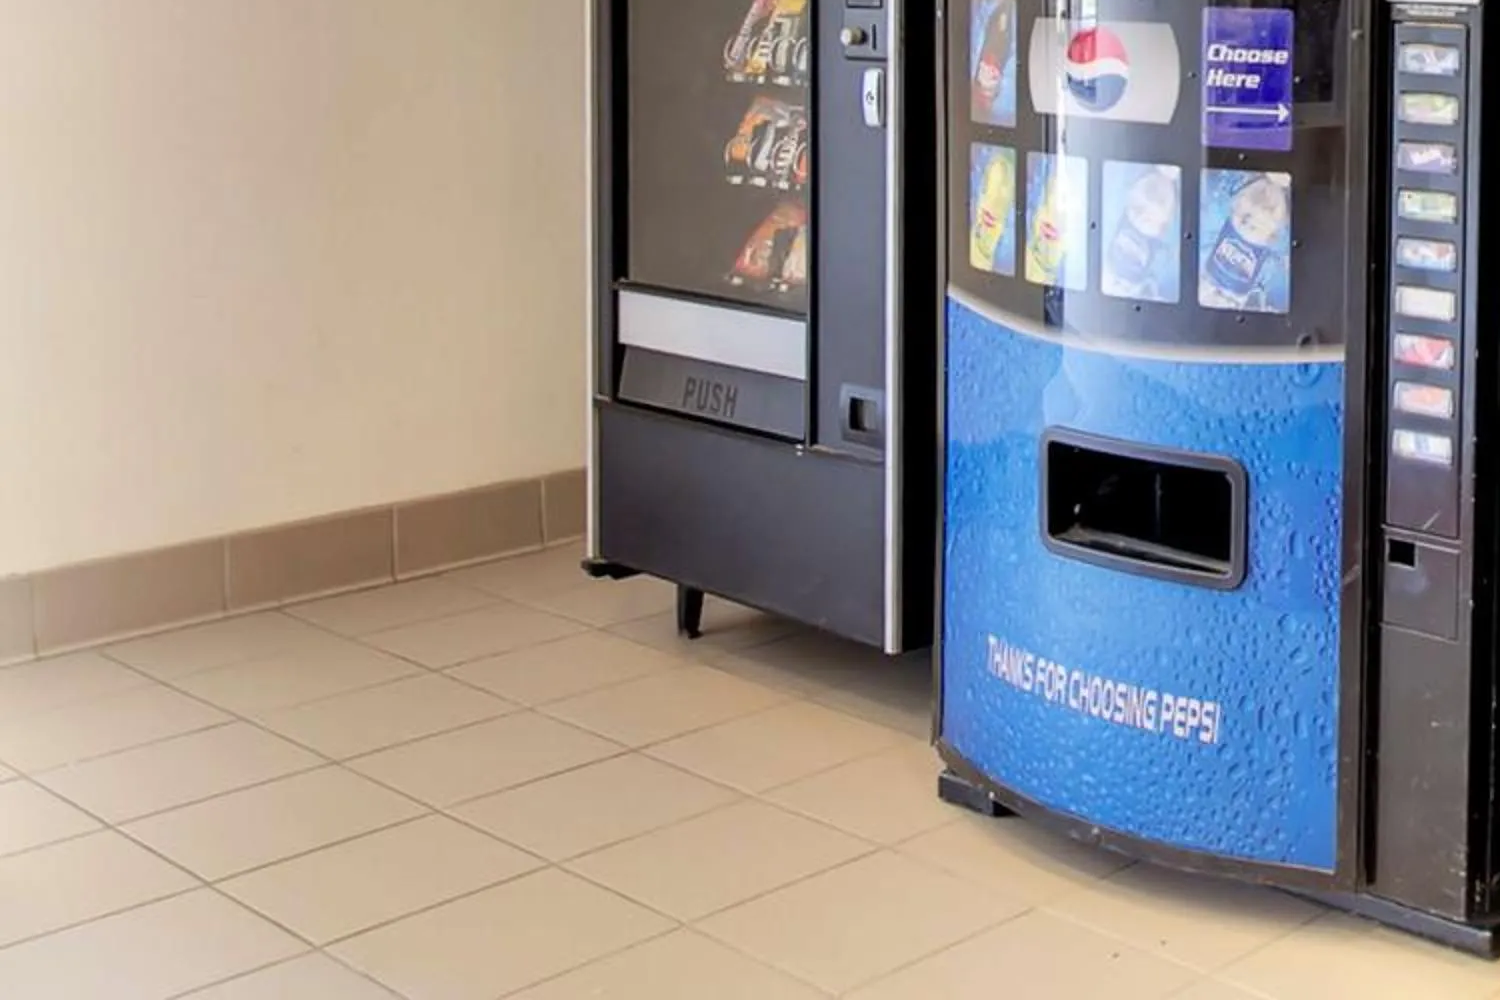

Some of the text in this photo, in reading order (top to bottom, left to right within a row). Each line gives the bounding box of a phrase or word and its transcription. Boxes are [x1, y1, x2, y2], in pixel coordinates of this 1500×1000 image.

[1207, 43, 1289, 65] Choose
[1206, 68, 1261, 89] Here
[682, 375, 740, 419] PUSH
[987, 632, 1222, 745] THANKS FOR CHOOSING PEPSI
